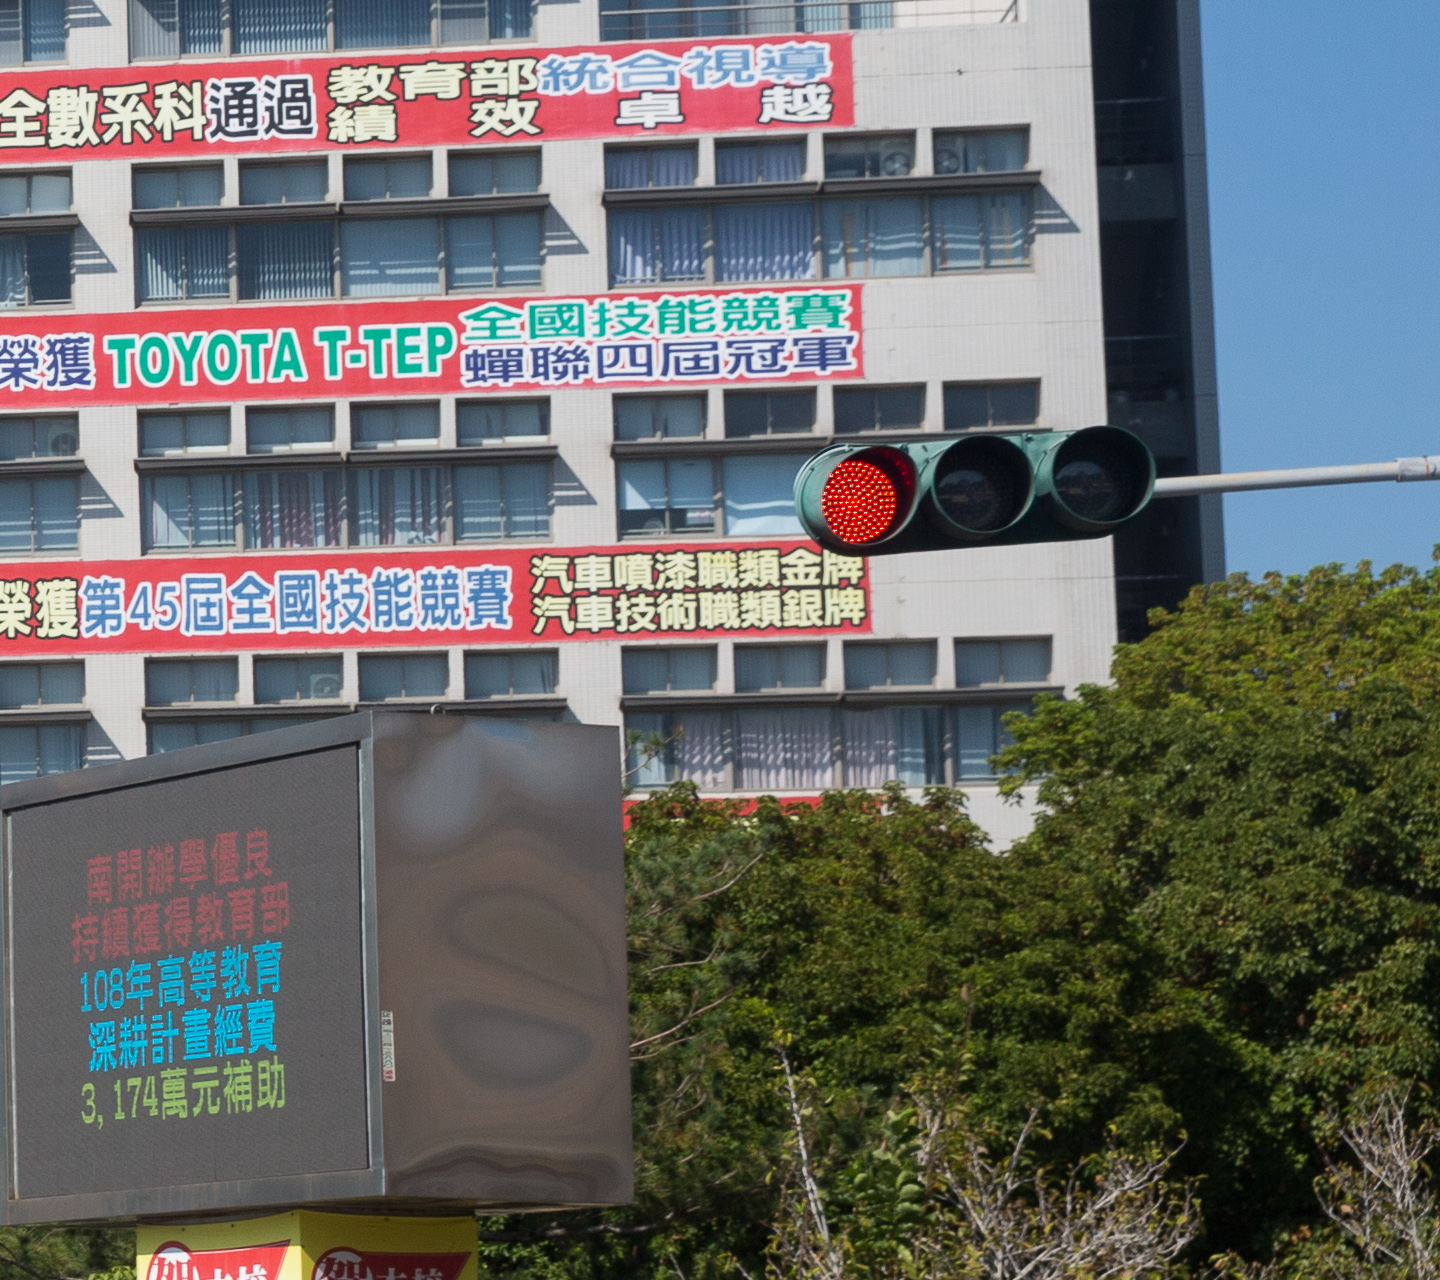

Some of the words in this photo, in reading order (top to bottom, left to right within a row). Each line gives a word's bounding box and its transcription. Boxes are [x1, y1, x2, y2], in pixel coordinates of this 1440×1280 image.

[328, 41, 832, 104] 教育部統合視導
[106, 328, 307, 387] TOYOTA
[317, 325, 455, 379] T-TEP
[461, 290, 852, 341] 全國技能競賽
[462, 333, 857, 386] 蟬聯四屆冠軍
[531, 587, 867, 635] 汽車技術職類銀牌
[86, 827, 272, 906] 南開辦學優良
[71, 882, 290, 963] 持續獲得教育部
[80, 940, 282, 1012] 108年高等教育
[88, 998, 277, 1072] 深耕計畫經費
